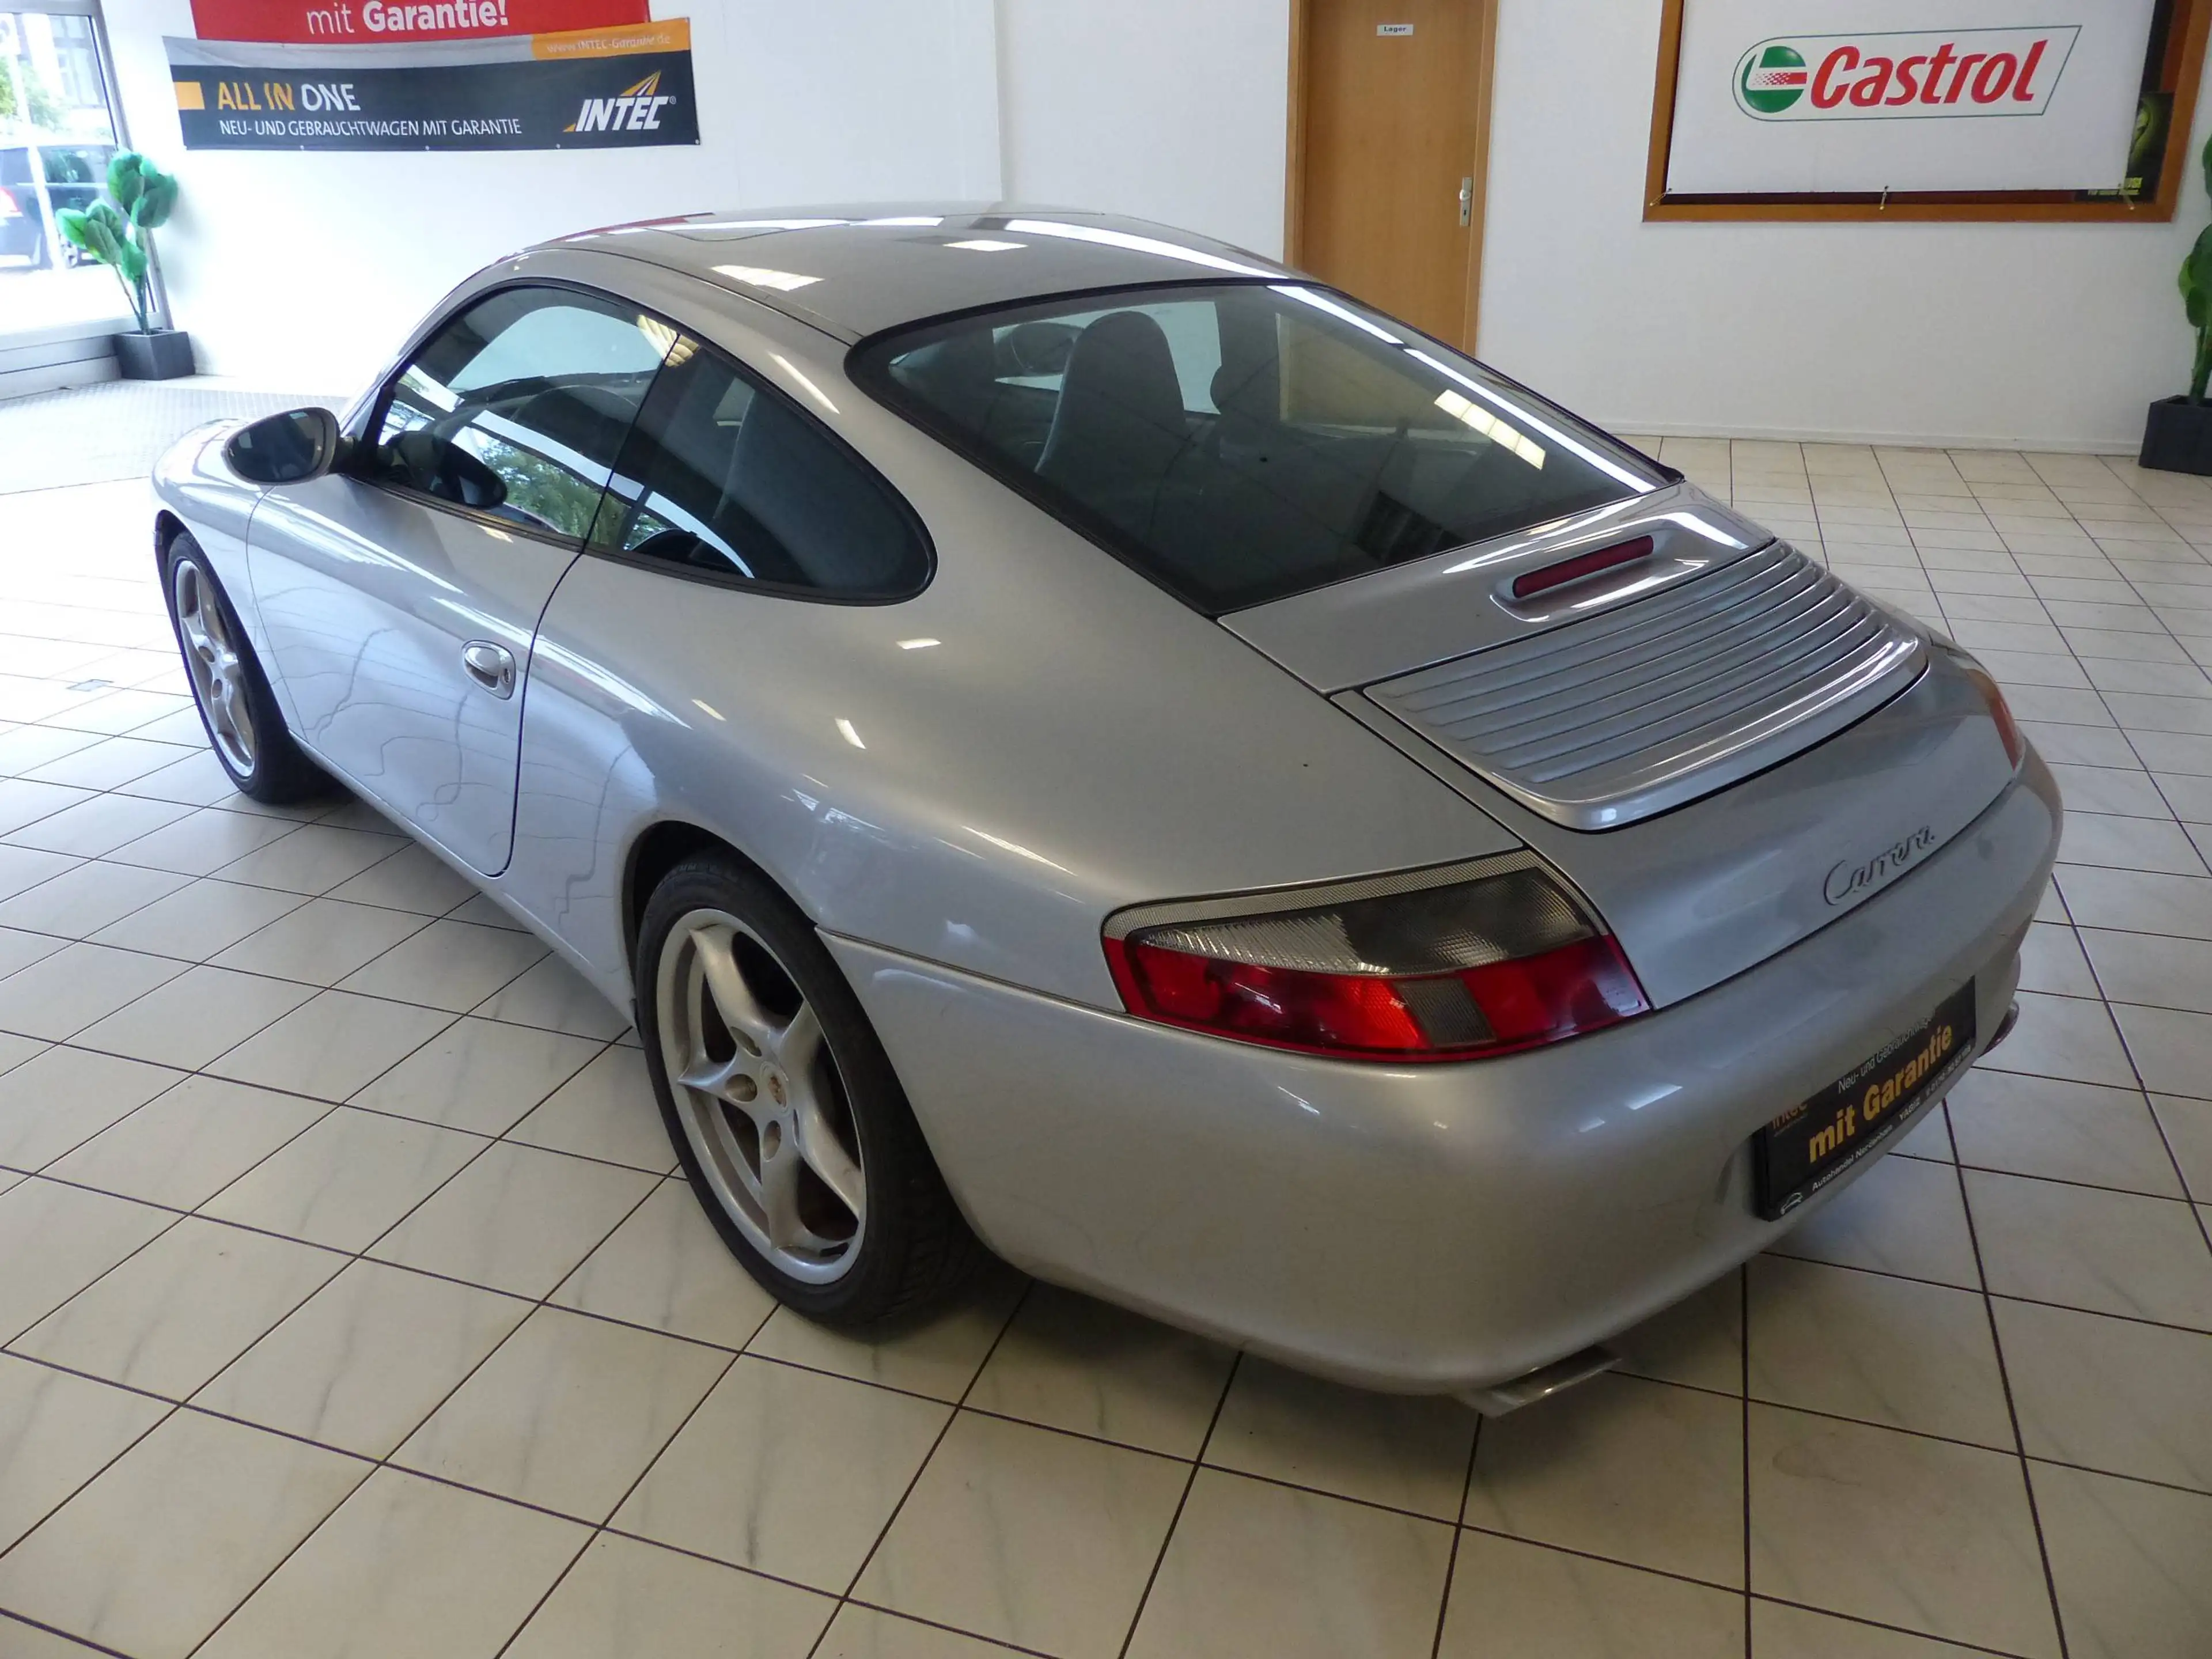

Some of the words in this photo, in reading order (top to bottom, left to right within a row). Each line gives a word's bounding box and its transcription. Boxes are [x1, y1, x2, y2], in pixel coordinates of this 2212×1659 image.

[306, 3, 355, 34] mit
[363, 0, 508, 32] Garantie!
[1810, 40, 2048, 109] Castrol
[218, 82, 262, 110] ALL
[264, 82, 296, 111] IN
[301, 83, 361, 111] ONE
[575, 96, 669, 131] INTEC
[219, 119, 252, 135] NEU-
[256, 120, 286, 136] UND
[289, 119, 419, 136] GEBRAUCHTWAGEN
[423, 119, 448, 135] MIT
[451, 118, 522, 135] GARANTIE
[1824, 826, 1936, 906] Carrera
[1809, 1104, 1855, 1163] mit
[1863, 1025, 1952, 1120] Garantie
